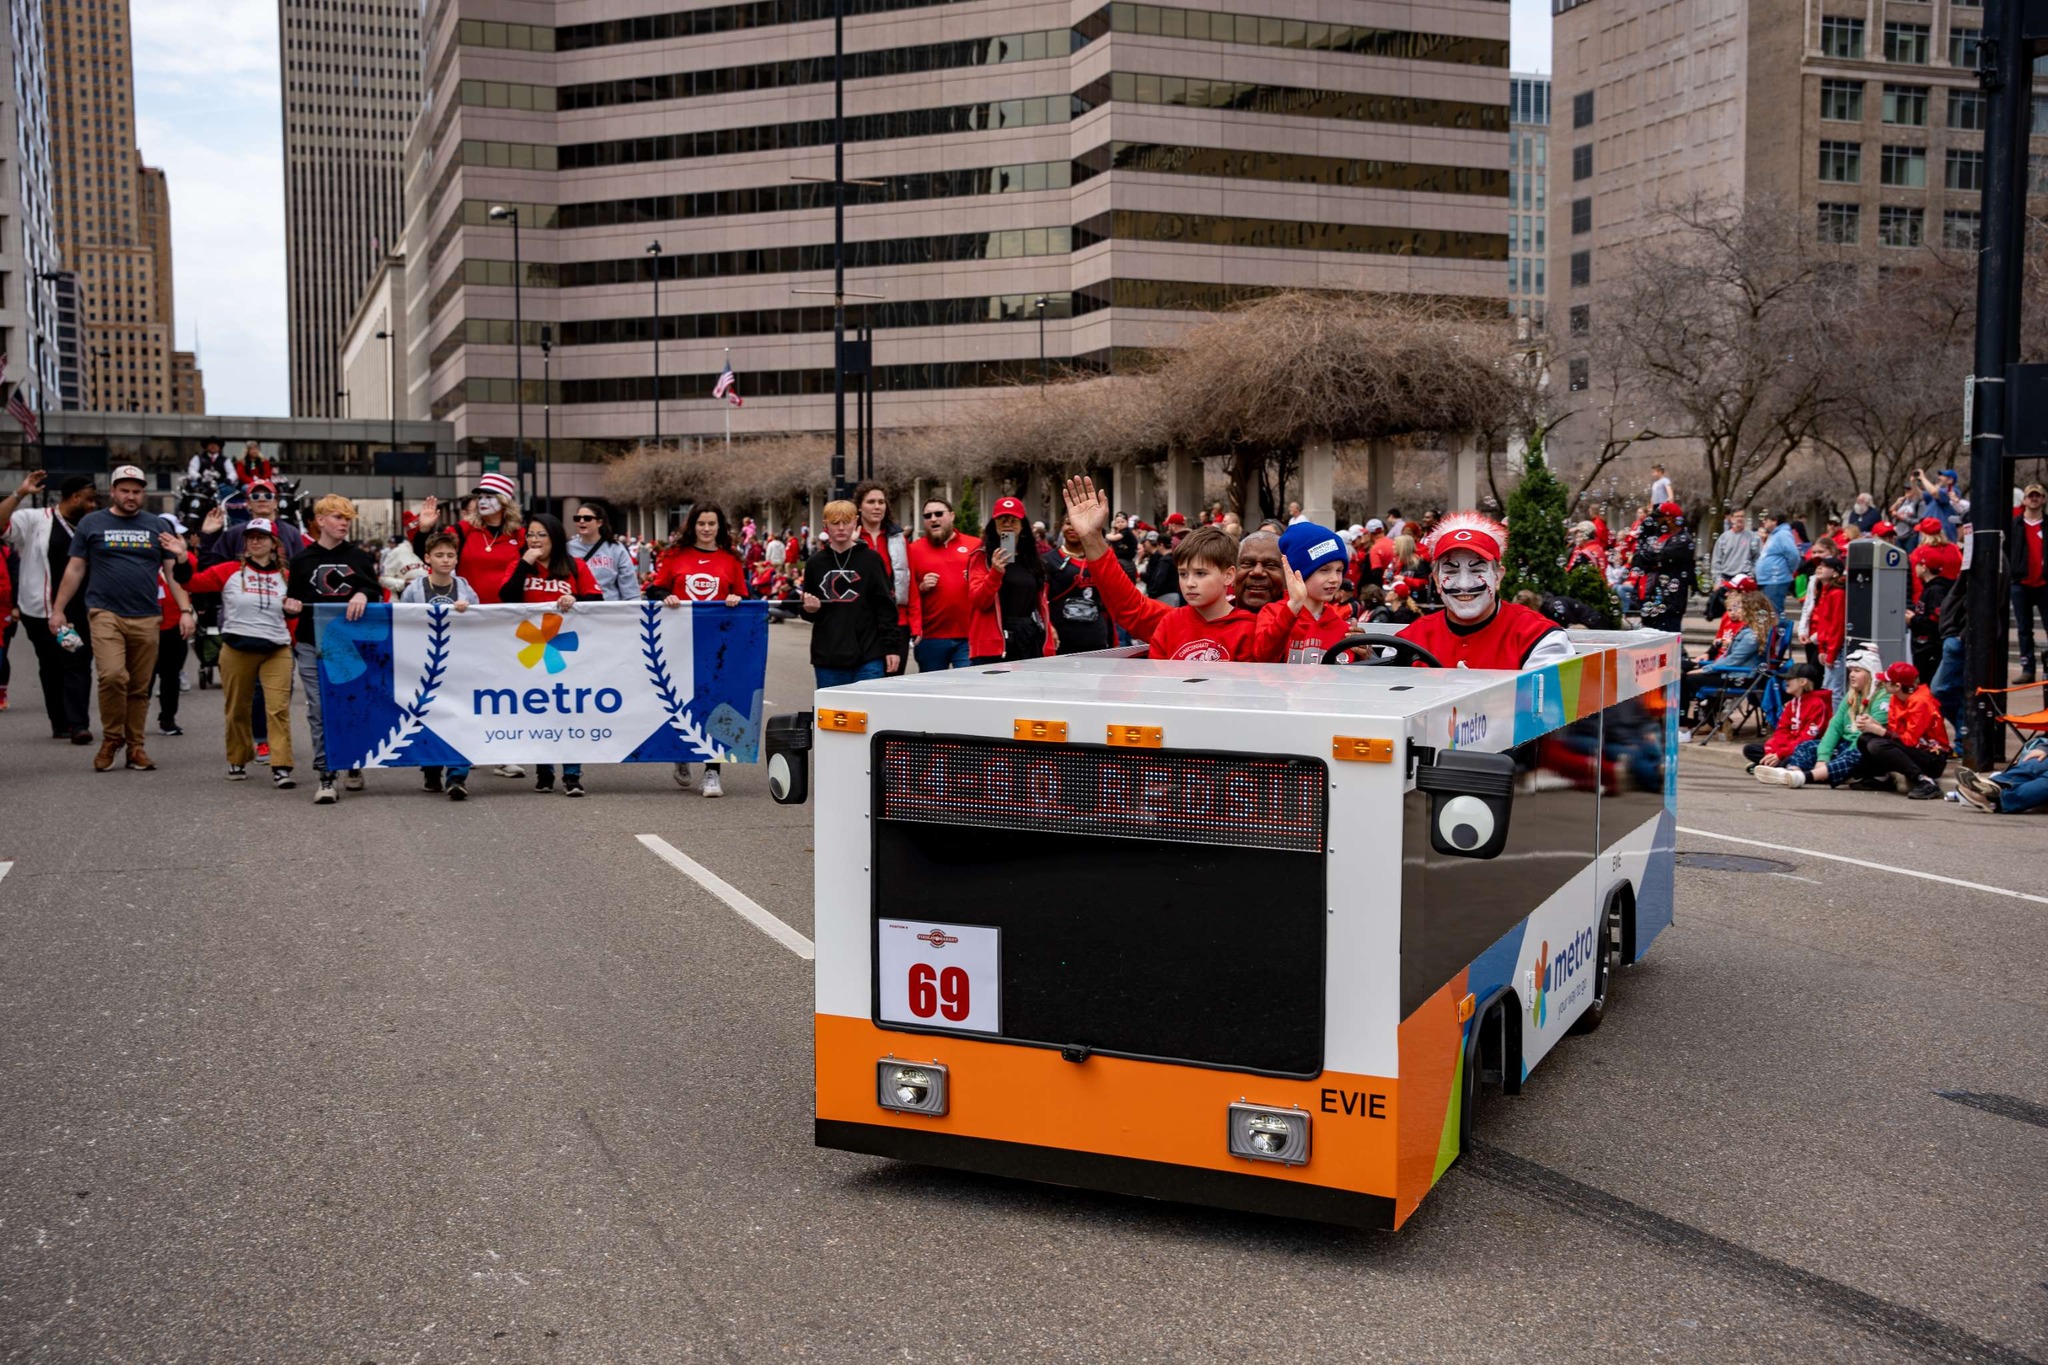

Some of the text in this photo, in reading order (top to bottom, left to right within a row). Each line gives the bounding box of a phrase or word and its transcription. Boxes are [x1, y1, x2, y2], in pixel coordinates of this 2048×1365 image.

[1889, 552, 1898, 565] P
[694, 580, 716, 588] REDS
[473, 683, 623, 715] metro
[485, 727, 613, 744] your way to go
[1461, 712, 1487, 747] metro
[1554, 926, 1593, 992] metro
[908, 963, 970, 1022] 69
[1321, 1088, 1387, 1119] EVIE
